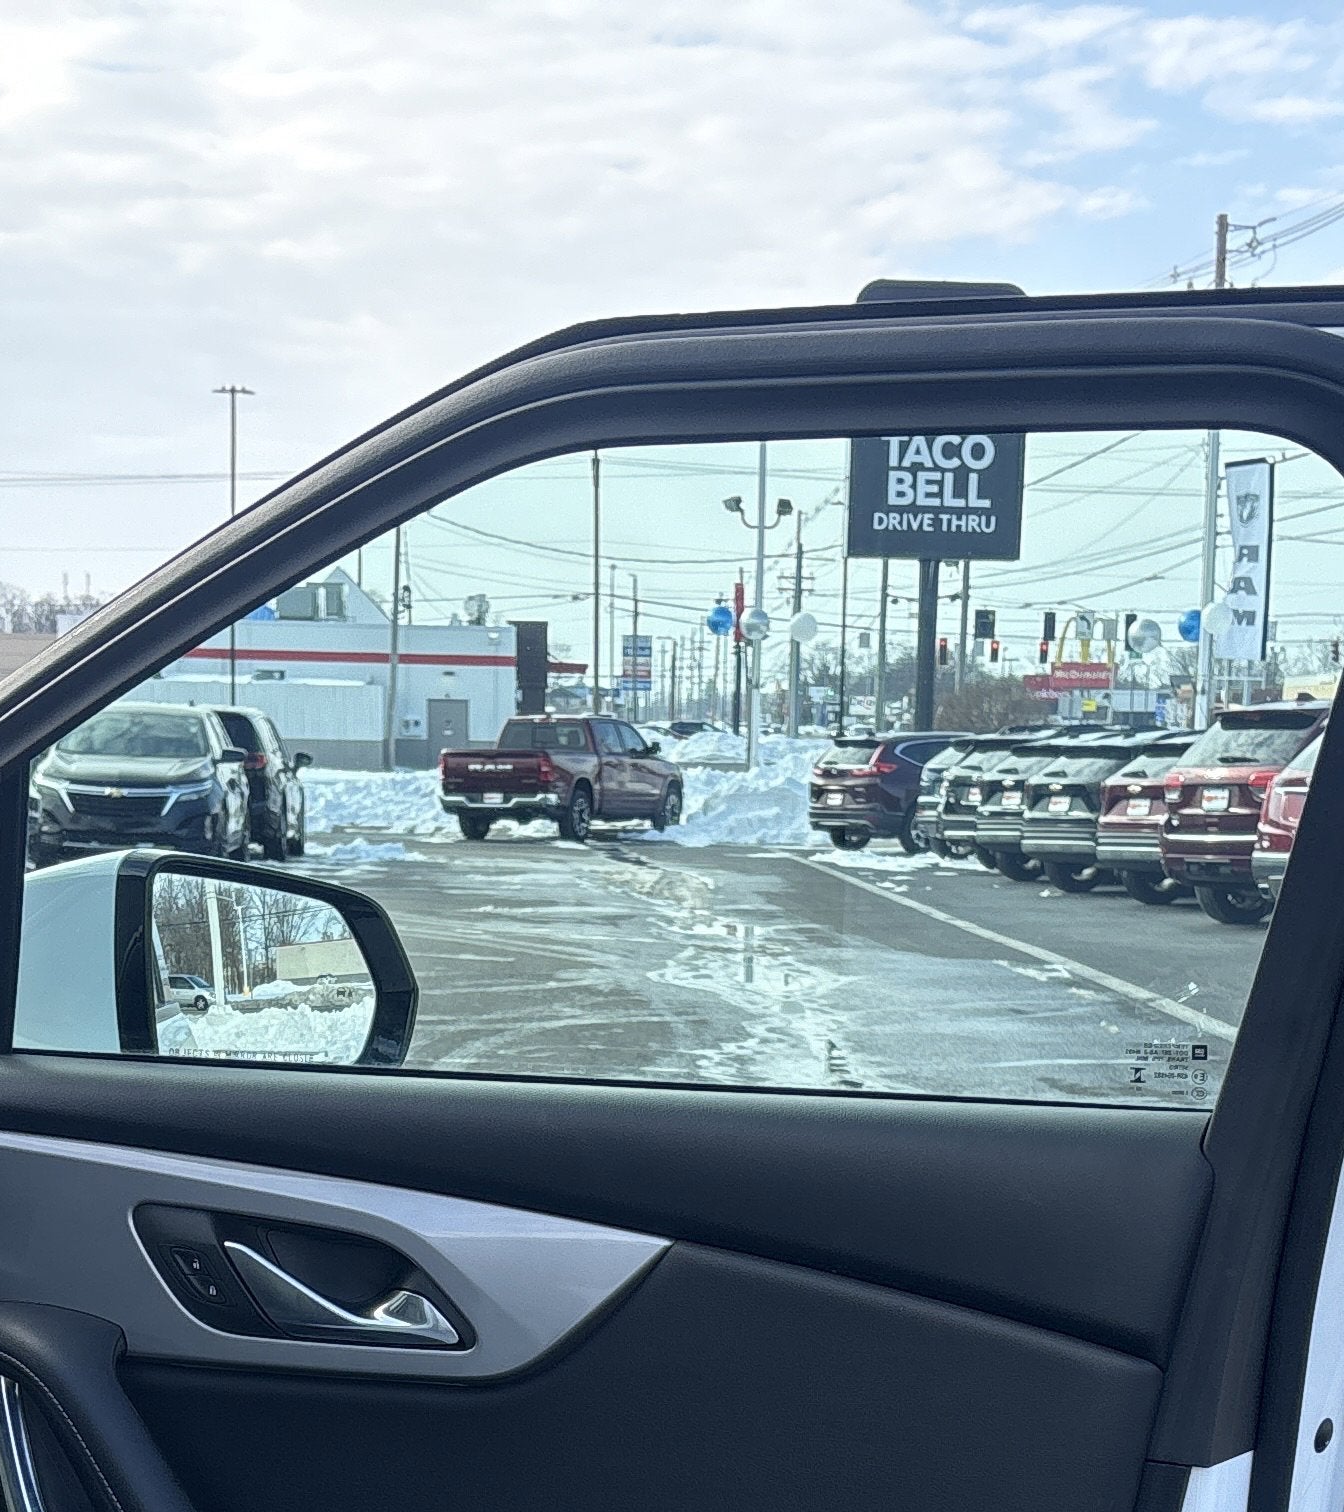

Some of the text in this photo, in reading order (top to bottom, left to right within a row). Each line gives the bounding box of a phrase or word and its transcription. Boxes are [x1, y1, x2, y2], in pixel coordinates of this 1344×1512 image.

[881, 435, 996, 470] TACO
[887, 470, 992, 508] BELL
[873, 512, 996, 533] DRIVE THRU
